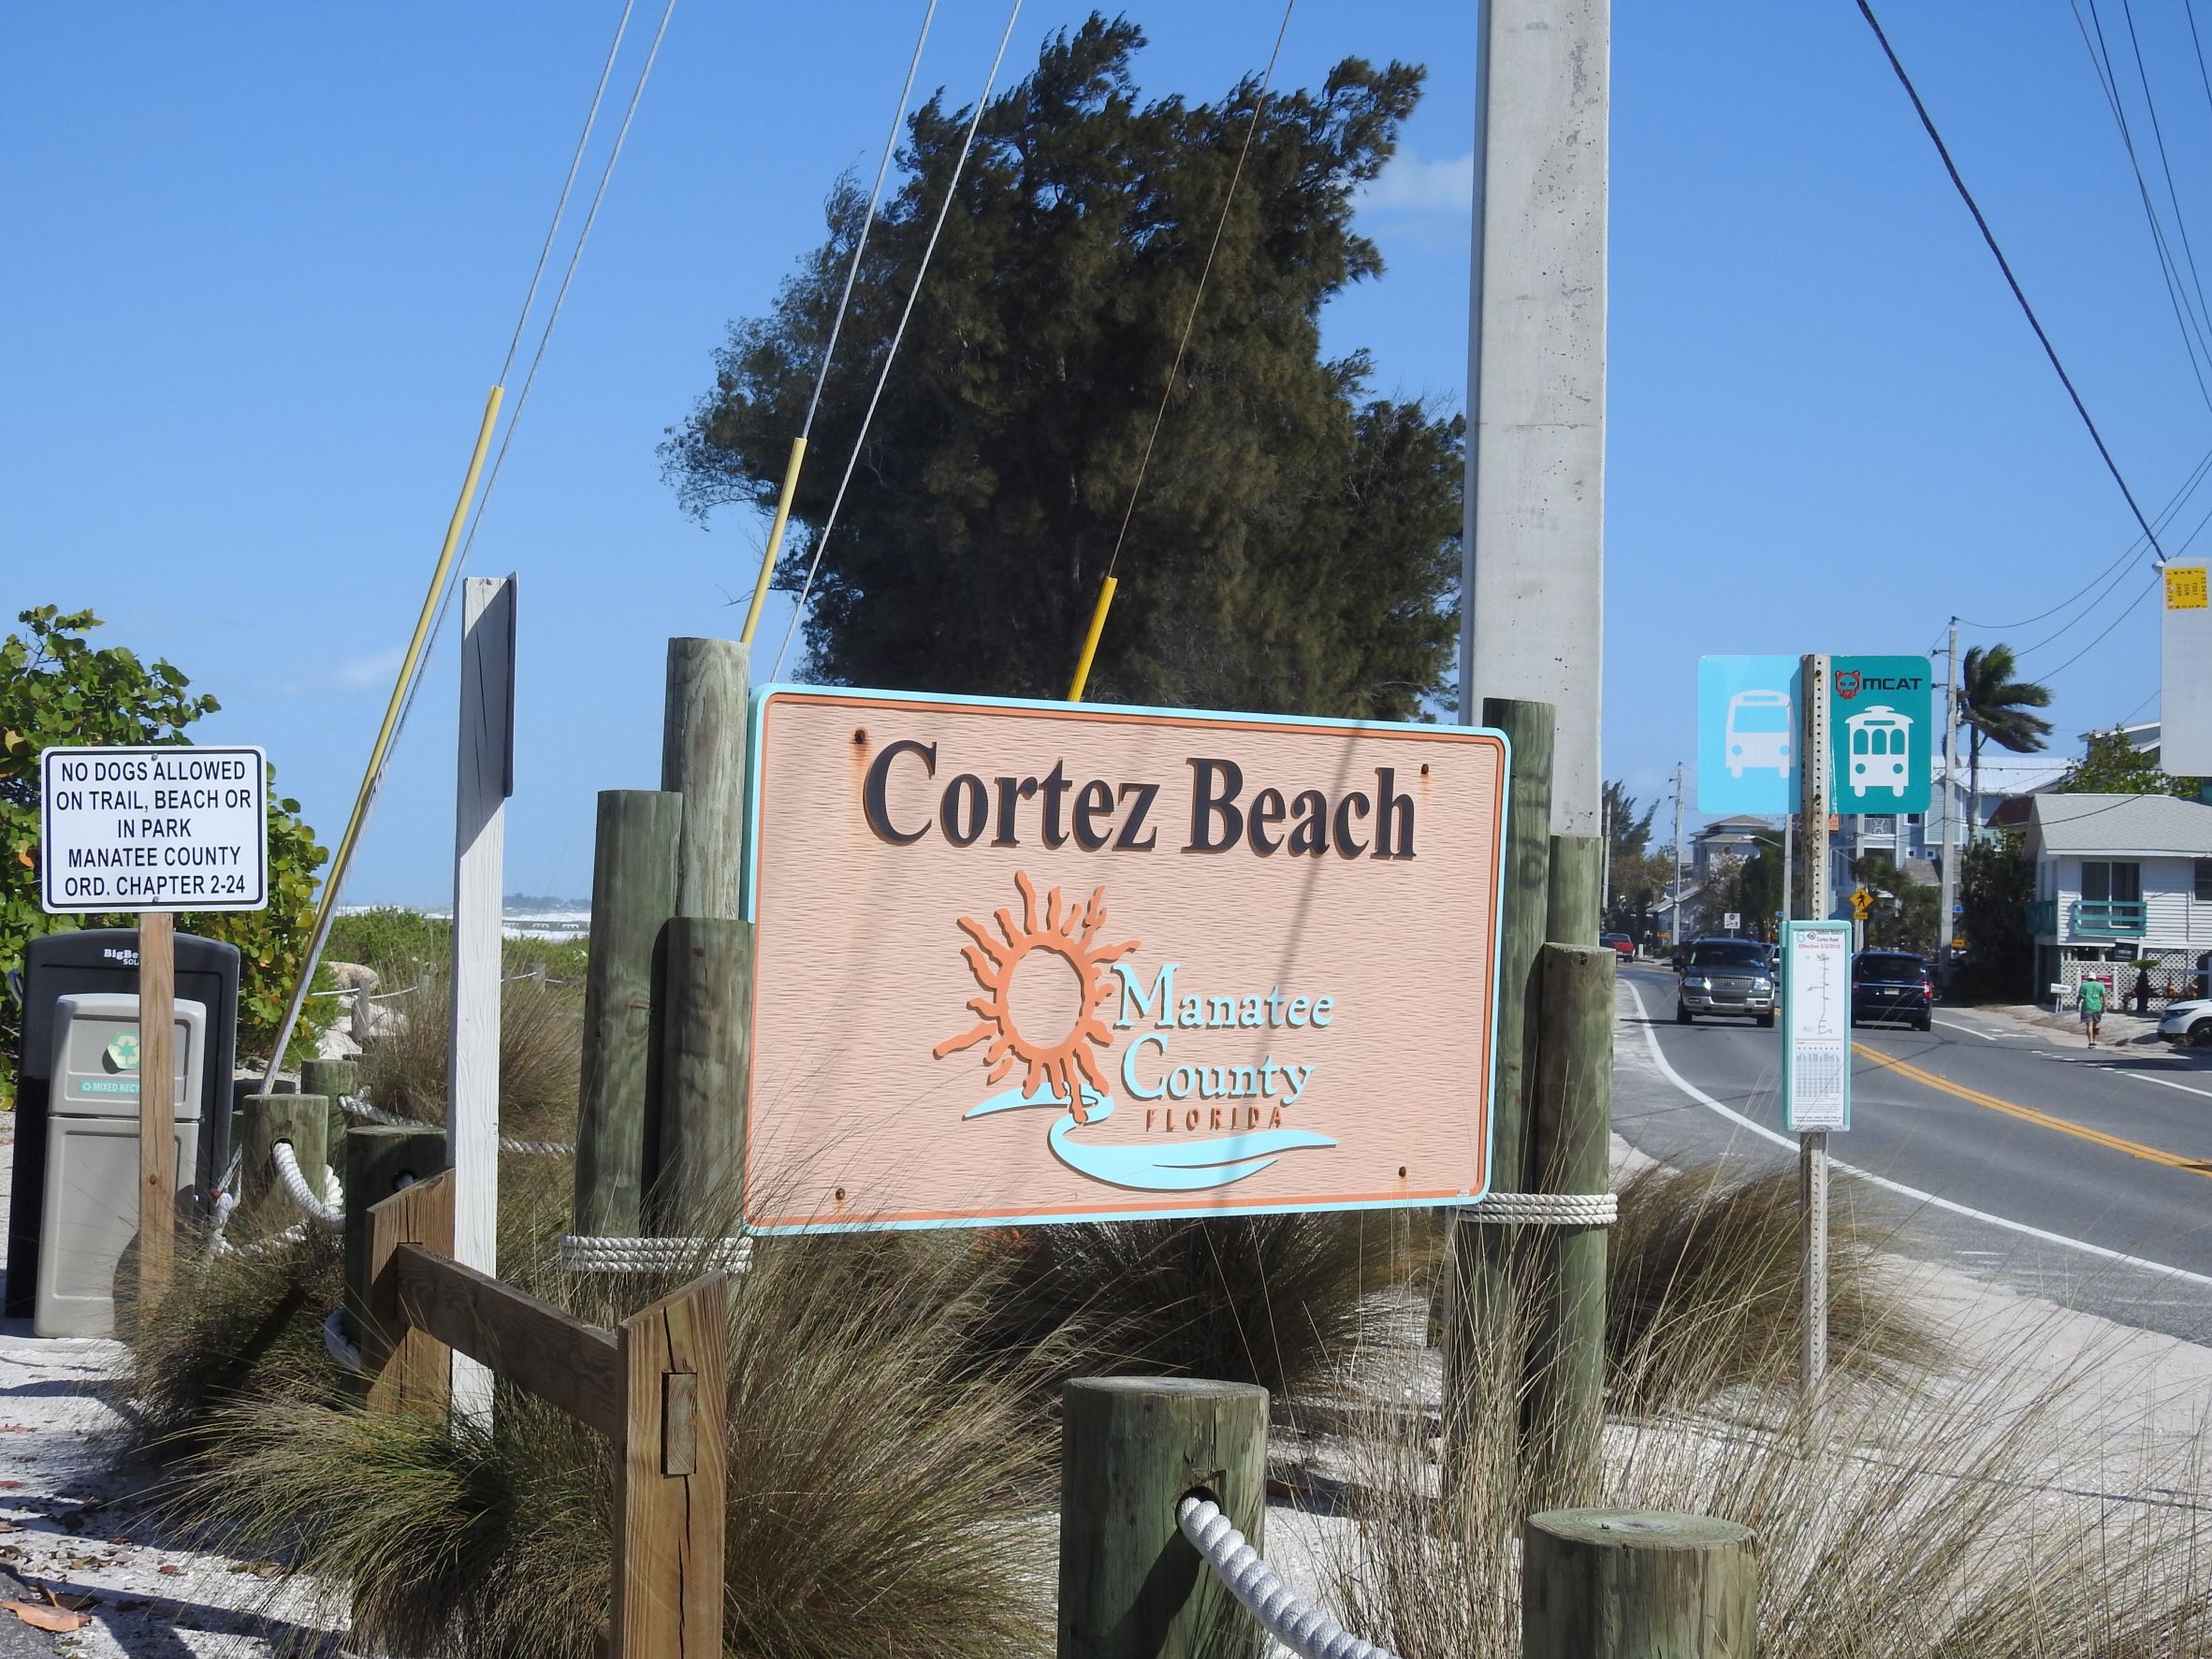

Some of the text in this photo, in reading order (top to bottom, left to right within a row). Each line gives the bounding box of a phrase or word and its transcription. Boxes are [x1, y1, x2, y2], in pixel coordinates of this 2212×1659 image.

[1863, 678, 1923, 691] MCAT
[62, 761, 246, 782] NO DOGS ALLOWED
[56, 789, 252, 812] ON TRAIL, BEACH OR
[863, 739, 1417, 861] Cortez Beach
[118, 818, 192, 838] IN PARK
[68, 846, 241, 867] MANATEE COUNTY
[65, 874, 245, 896] ORD. CHAPTER 2-24
[1111, 963, 1334, 1029] Manatee
[1121, 1032, 1317, 1108] County
[94, 1083, 118, 1093] MIXED
[1145, 1106, 1284, 1133] FLORIDA
